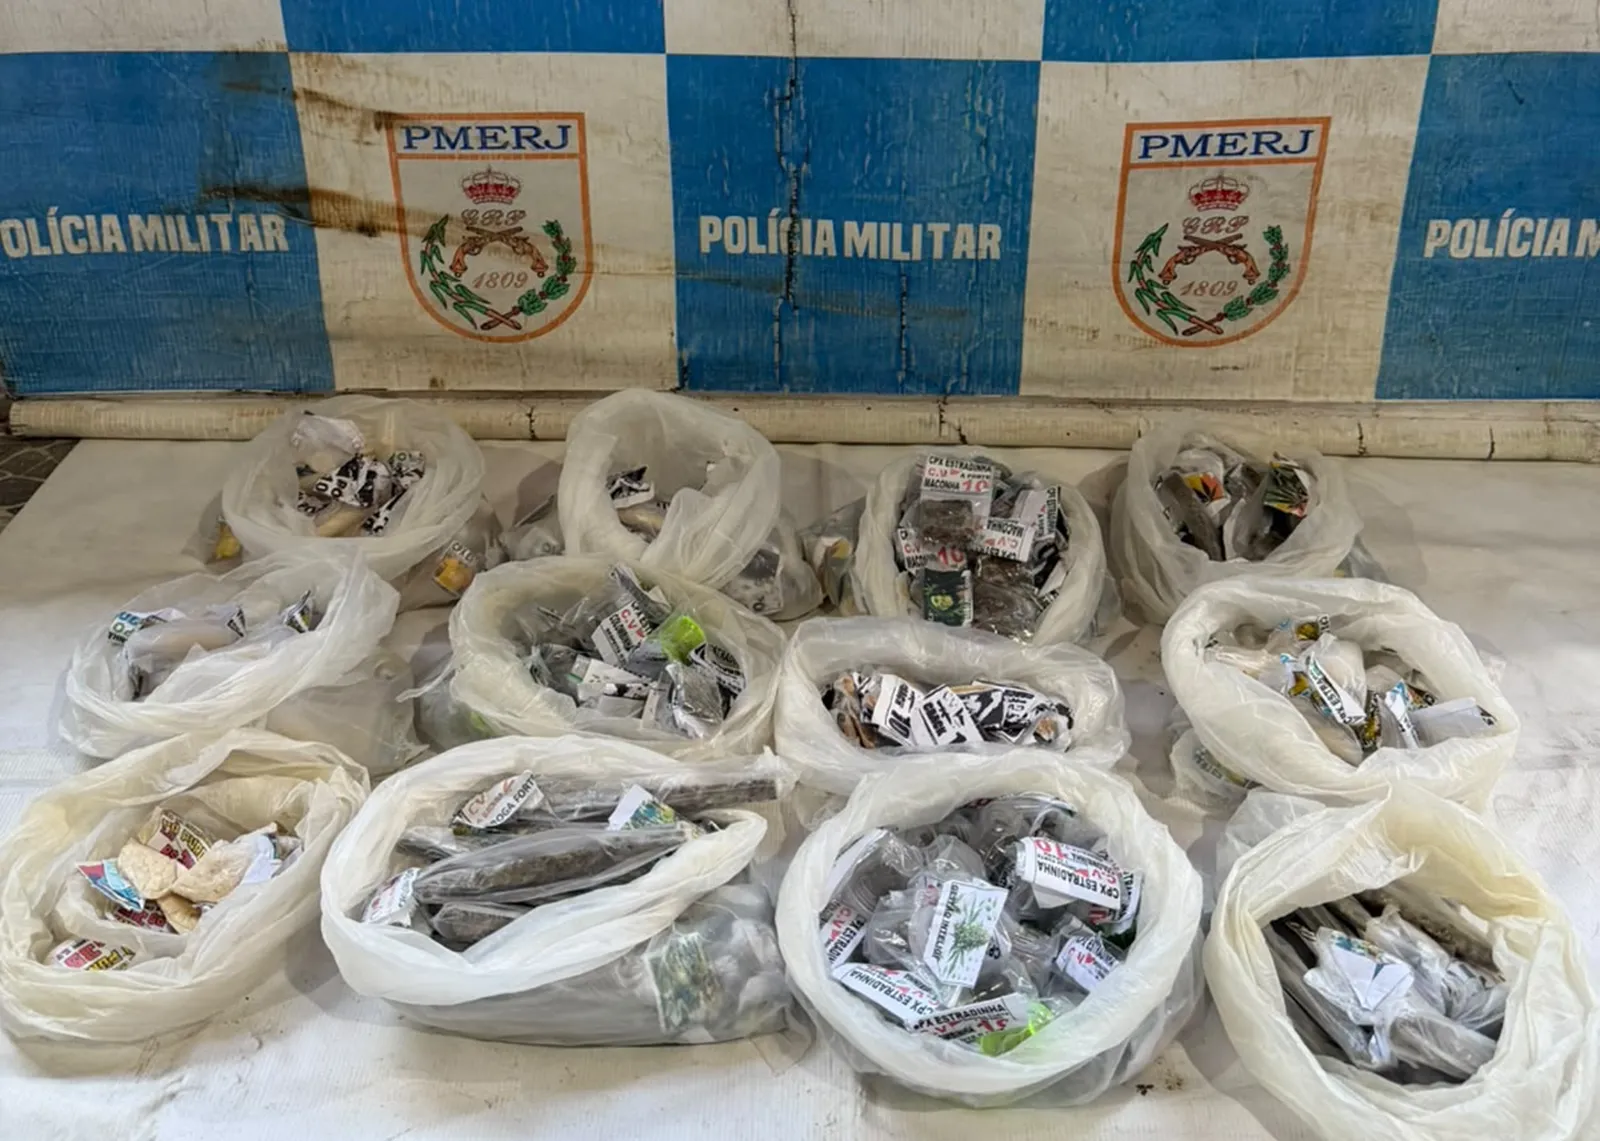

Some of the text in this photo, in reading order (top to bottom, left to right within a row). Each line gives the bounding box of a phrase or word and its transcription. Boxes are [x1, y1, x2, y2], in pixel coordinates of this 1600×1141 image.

[405, 125, 571, 150] PMERJ
[1139, 129, 1314, 160] PMERJ
[127, 213, 289, 254] MILITAR
[699, 207, 1001, 261] POLÍCIA MILITAR
[1423, 207, 1571, 259] POLÍCIA
[471, 270, 529, 290] 1809
[1179, 280, 1239, 297] 1809
[961, 479, 990, 493] 10
[888, 711, 911, 737] 10
[922, 702, 947, 737] CRACK
[1034, 838, 1072, 860] 10
[1037, 860, 1099, 893] ESTRADINHA
[1099, 878, 1120, 901] CPX
[847, 969, 913, 1009] ESTRADINHA
[934, 1002, 1006, 1026] ESTRADINHA
